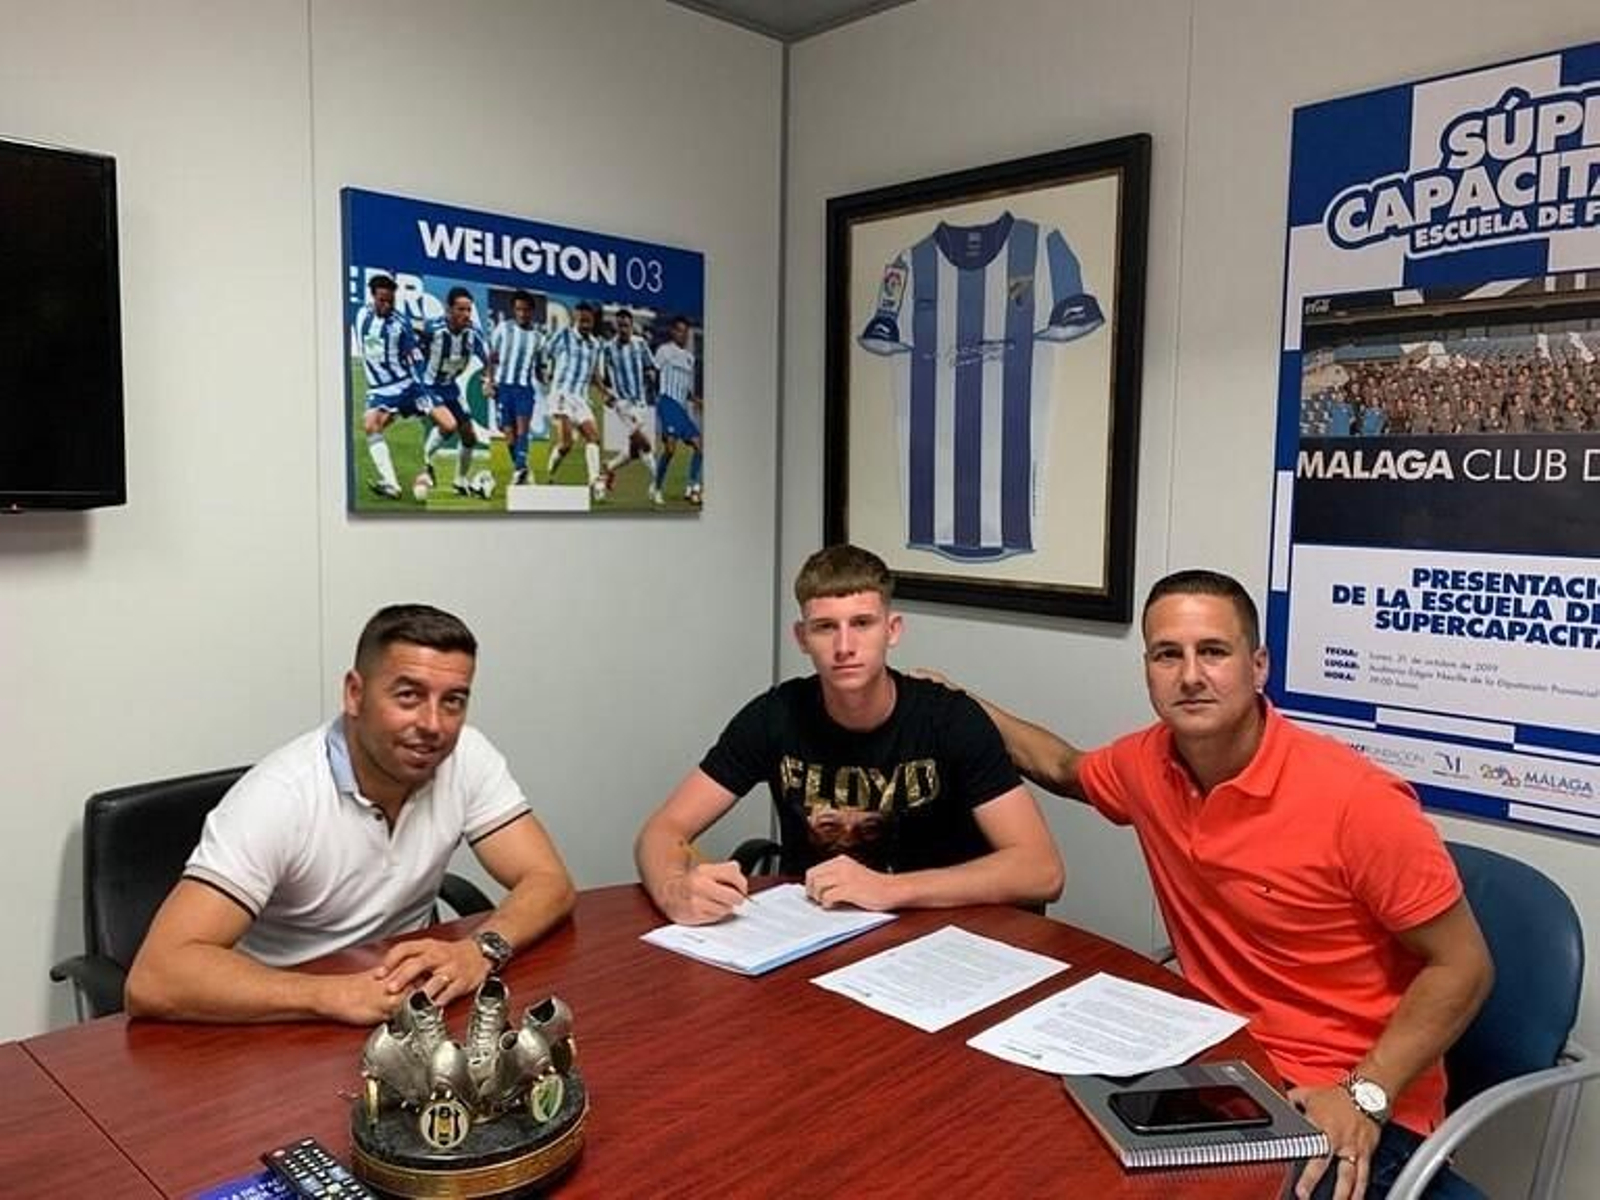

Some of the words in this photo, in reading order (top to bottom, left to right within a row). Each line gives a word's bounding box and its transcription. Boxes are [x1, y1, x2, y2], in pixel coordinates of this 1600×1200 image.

[1414, 209, 1528, 248] ESCUELA
[1538, 203, 1576, 228] DE
[417, 220, 617, 286] WELIGTON
[626, 257, 663, 293] 03
[1462, 448, 1567, 482] CLUB
[1332, 584, 1366, 605] DE
[1376, 587, 1411, 609] LA
[1422, 590, 1553, 621] ESCUELA
[1412, 567, 1600, 601] PRESENTACI
[1375, 609, 1600, 650] SUPERCAPACIT
[781, 755, 940, 815] FLOYD
